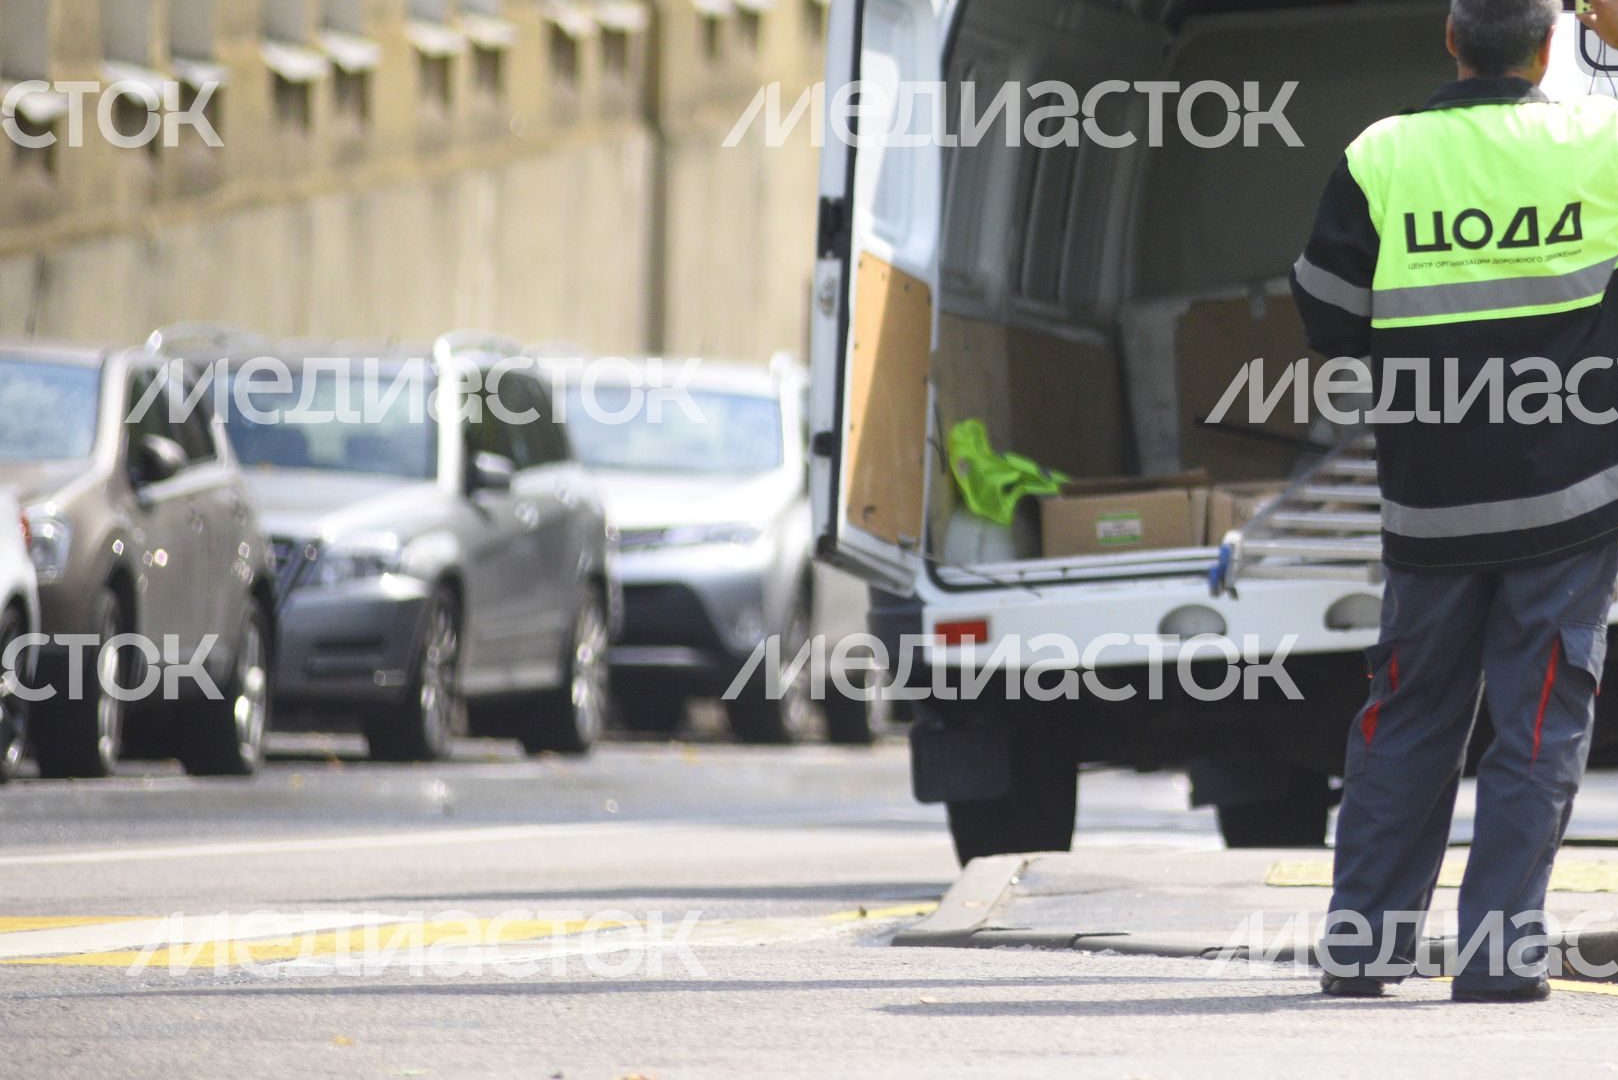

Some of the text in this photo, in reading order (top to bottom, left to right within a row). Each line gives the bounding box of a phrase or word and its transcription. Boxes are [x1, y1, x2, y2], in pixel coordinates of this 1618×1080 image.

[1404, 201, 1583, 253] ЦОДД
[1408, 261, 1433, 271] ЦЕНТР
[1491, 256, 1543, 265] ДОРОЖНОГО
